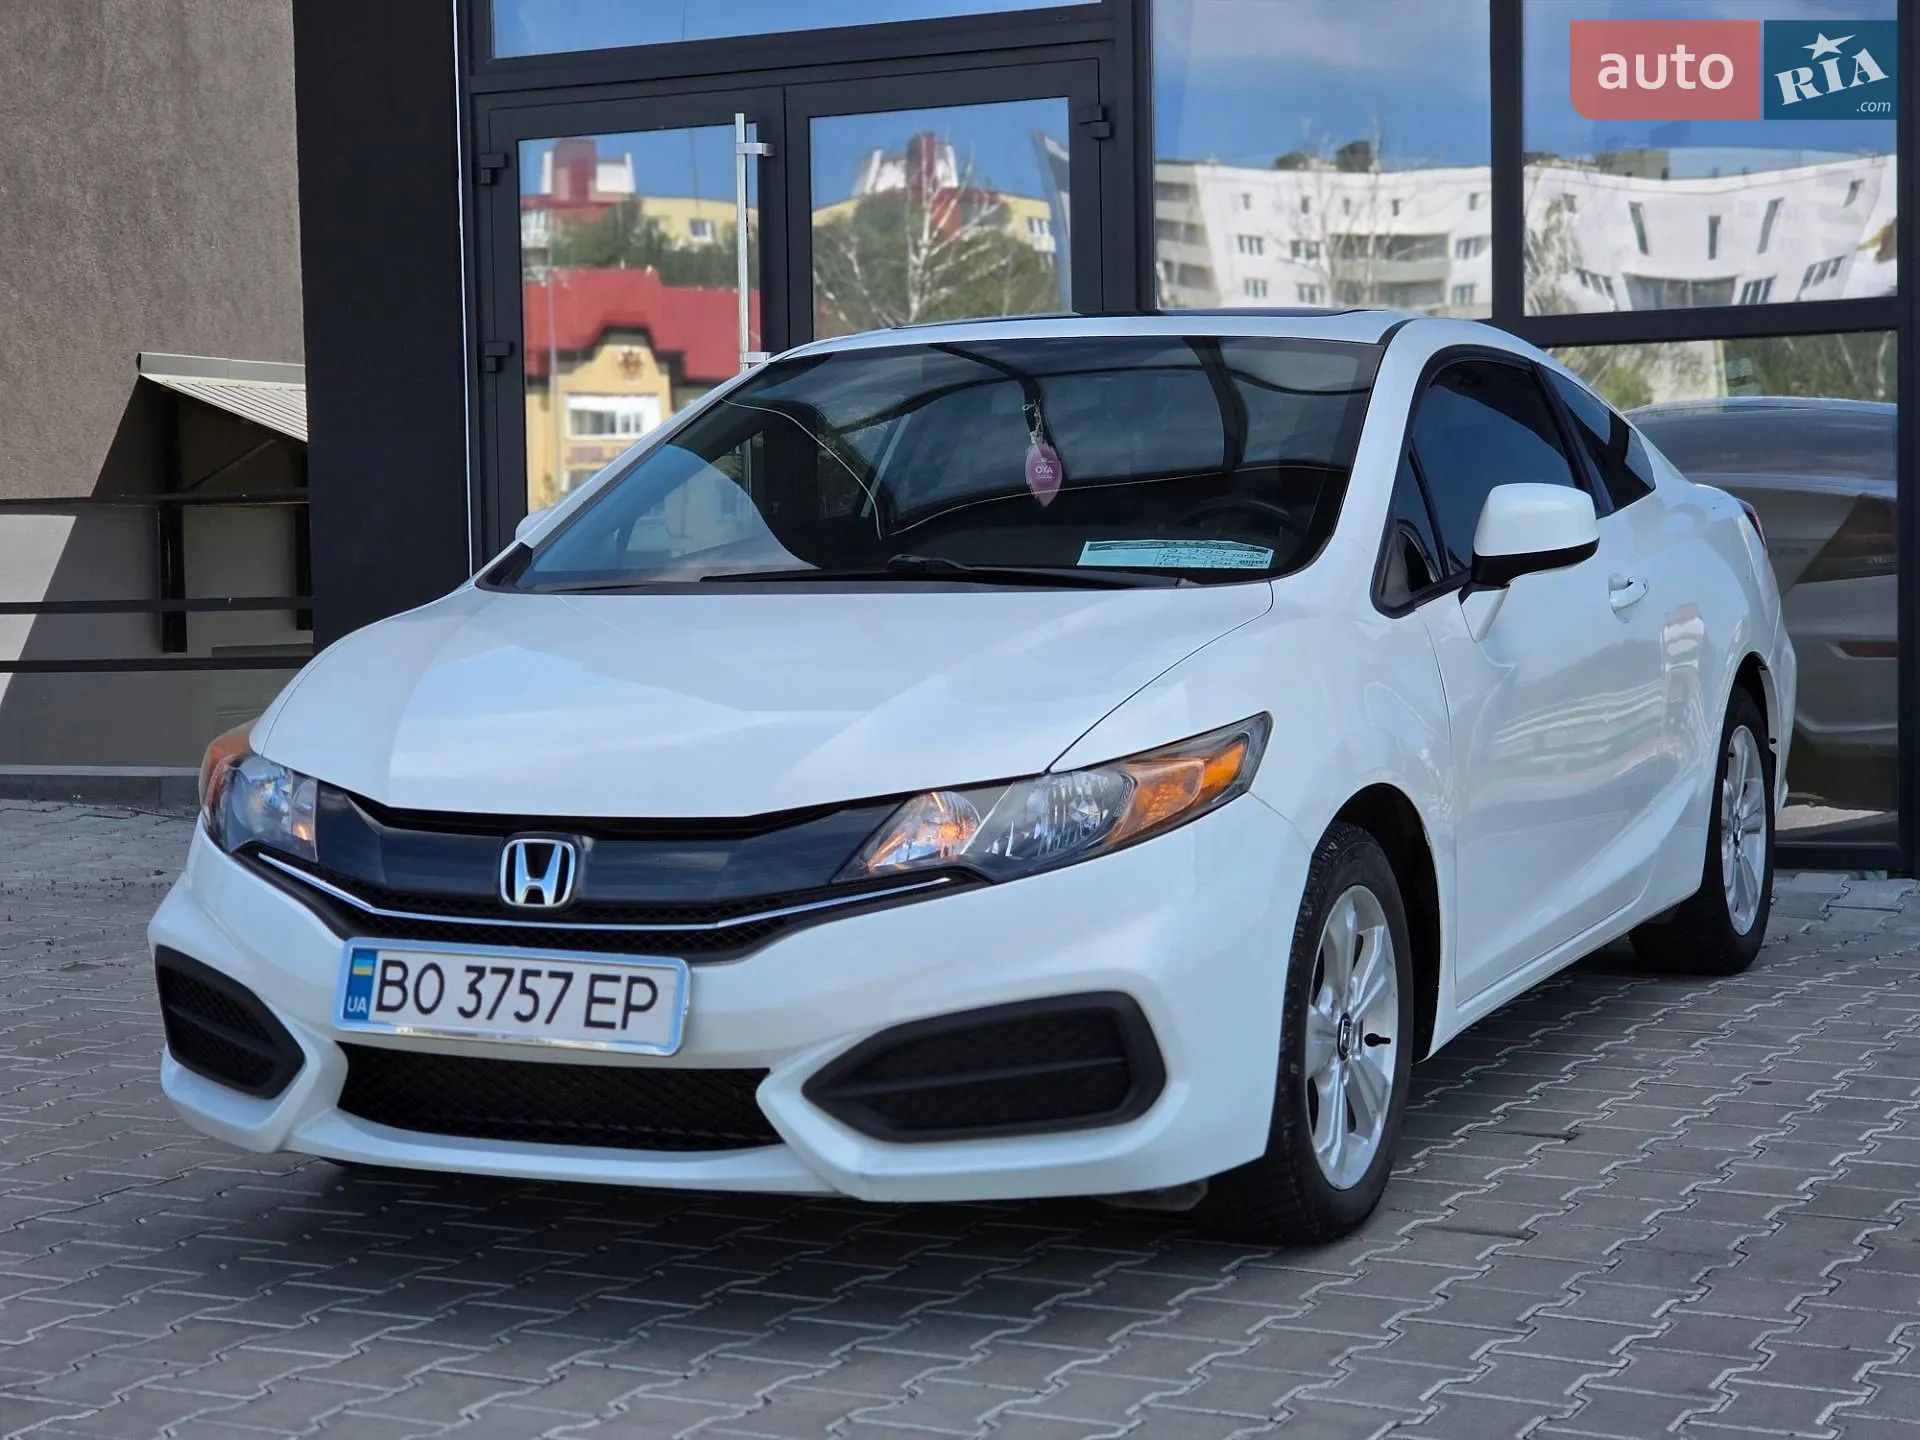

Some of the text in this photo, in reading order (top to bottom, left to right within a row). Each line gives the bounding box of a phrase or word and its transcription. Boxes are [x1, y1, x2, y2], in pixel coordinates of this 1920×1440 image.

[347, 996, 367, 1014] UA
[375, 959, 659, 1030] BO 3757 EP
